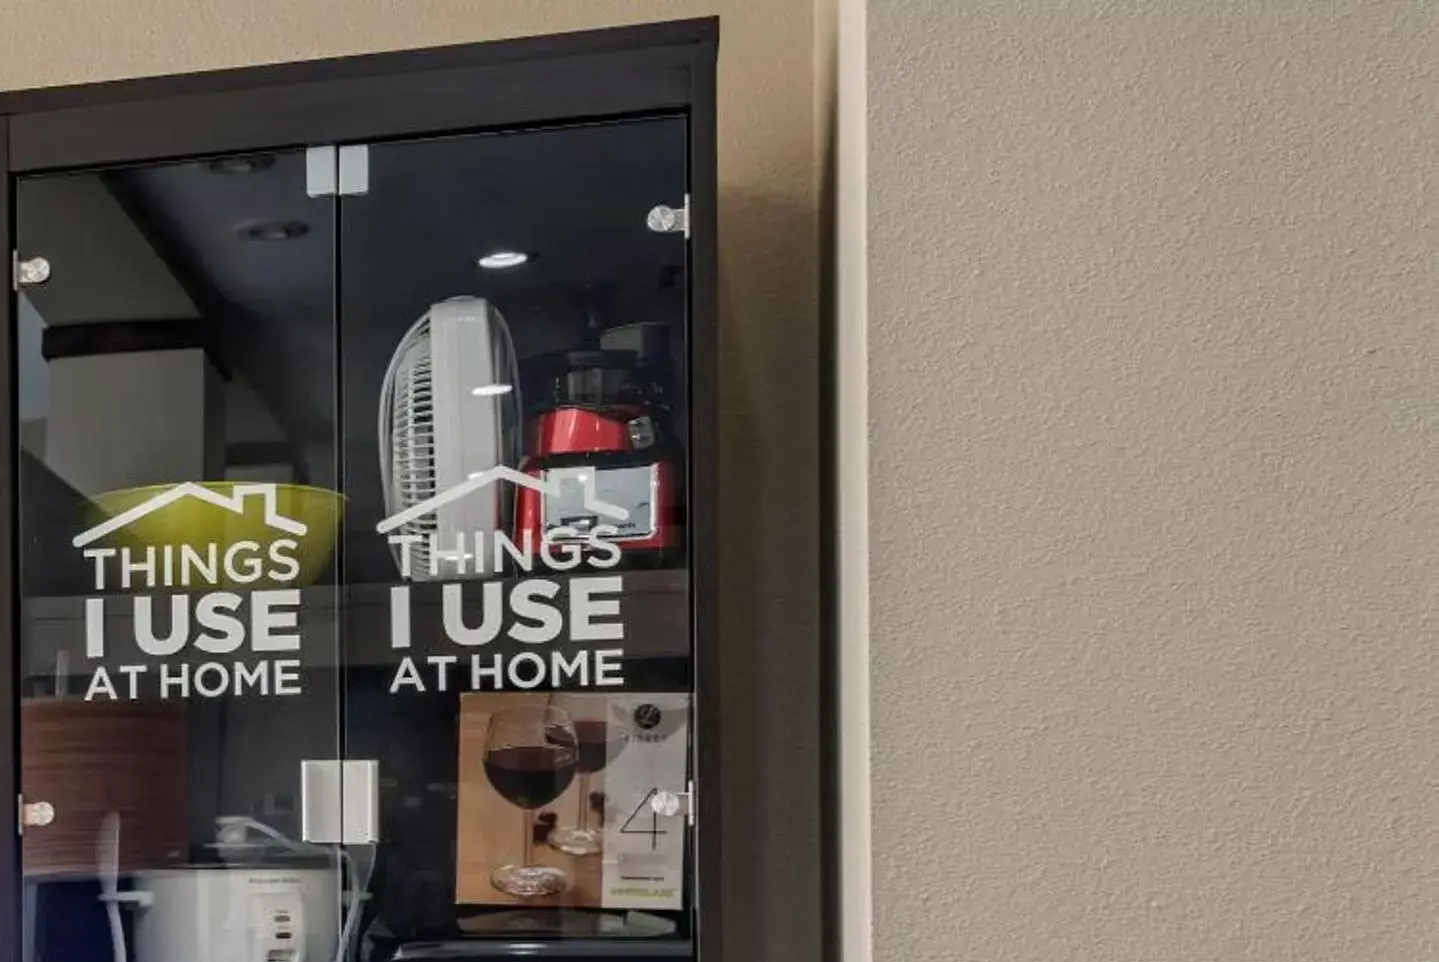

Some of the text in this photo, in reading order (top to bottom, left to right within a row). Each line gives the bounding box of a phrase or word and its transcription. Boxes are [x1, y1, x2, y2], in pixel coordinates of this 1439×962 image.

[83, 538, 301, 591] THINGS
[387, 524, 623, 578] THINGS
[85, 588, 302, 659] I USE
[390, 575, 625, 650] I USE
[84, 658, 302, 702] AT HOME
[389, 648, 625, 694] AT HOME
[619, 786, 668, 851] 4
